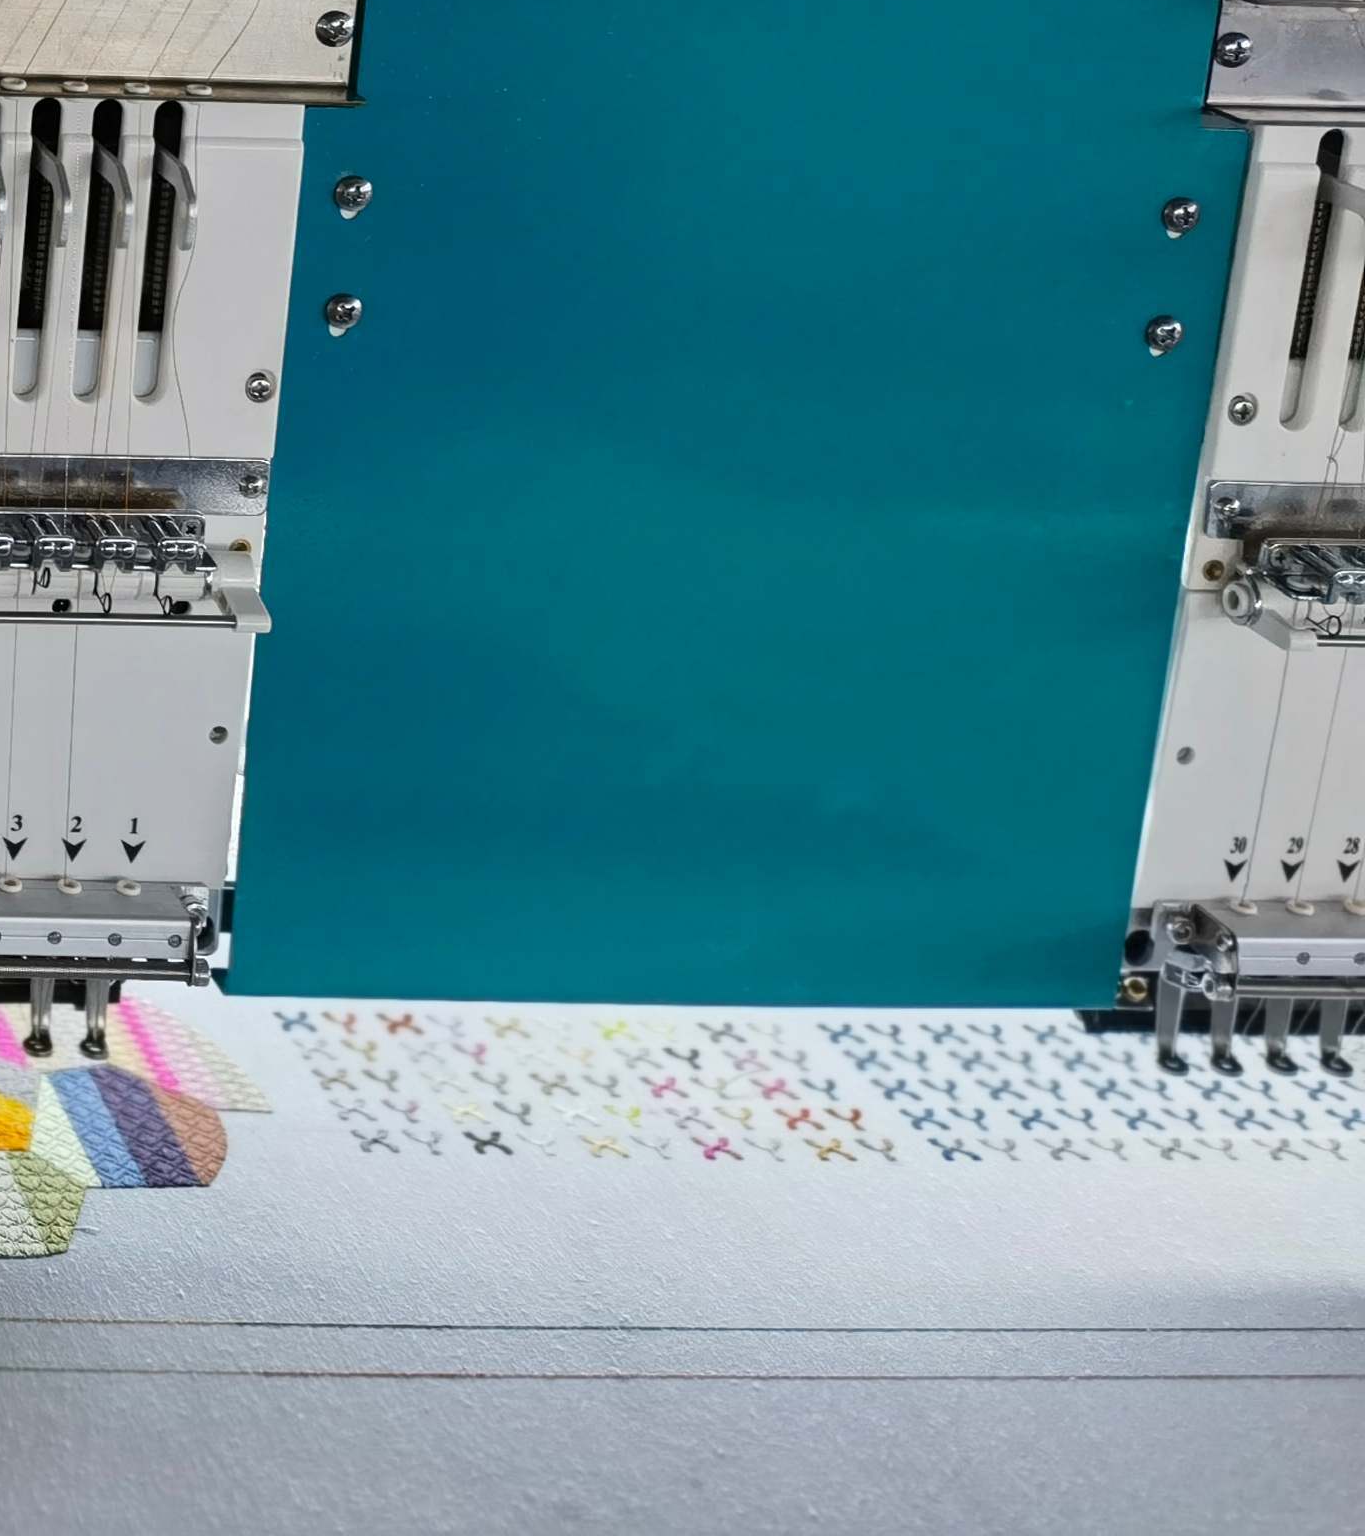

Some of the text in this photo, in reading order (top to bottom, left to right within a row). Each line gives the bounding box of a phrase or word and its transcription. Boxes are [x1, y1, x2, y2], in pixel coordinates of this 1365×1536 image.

[10, 814, 23, 832] 3
[70, 815, 82, 833] 2
[130, 817, 139, 835] 1
[1230, 836, 1361, 855] 30 29 28
